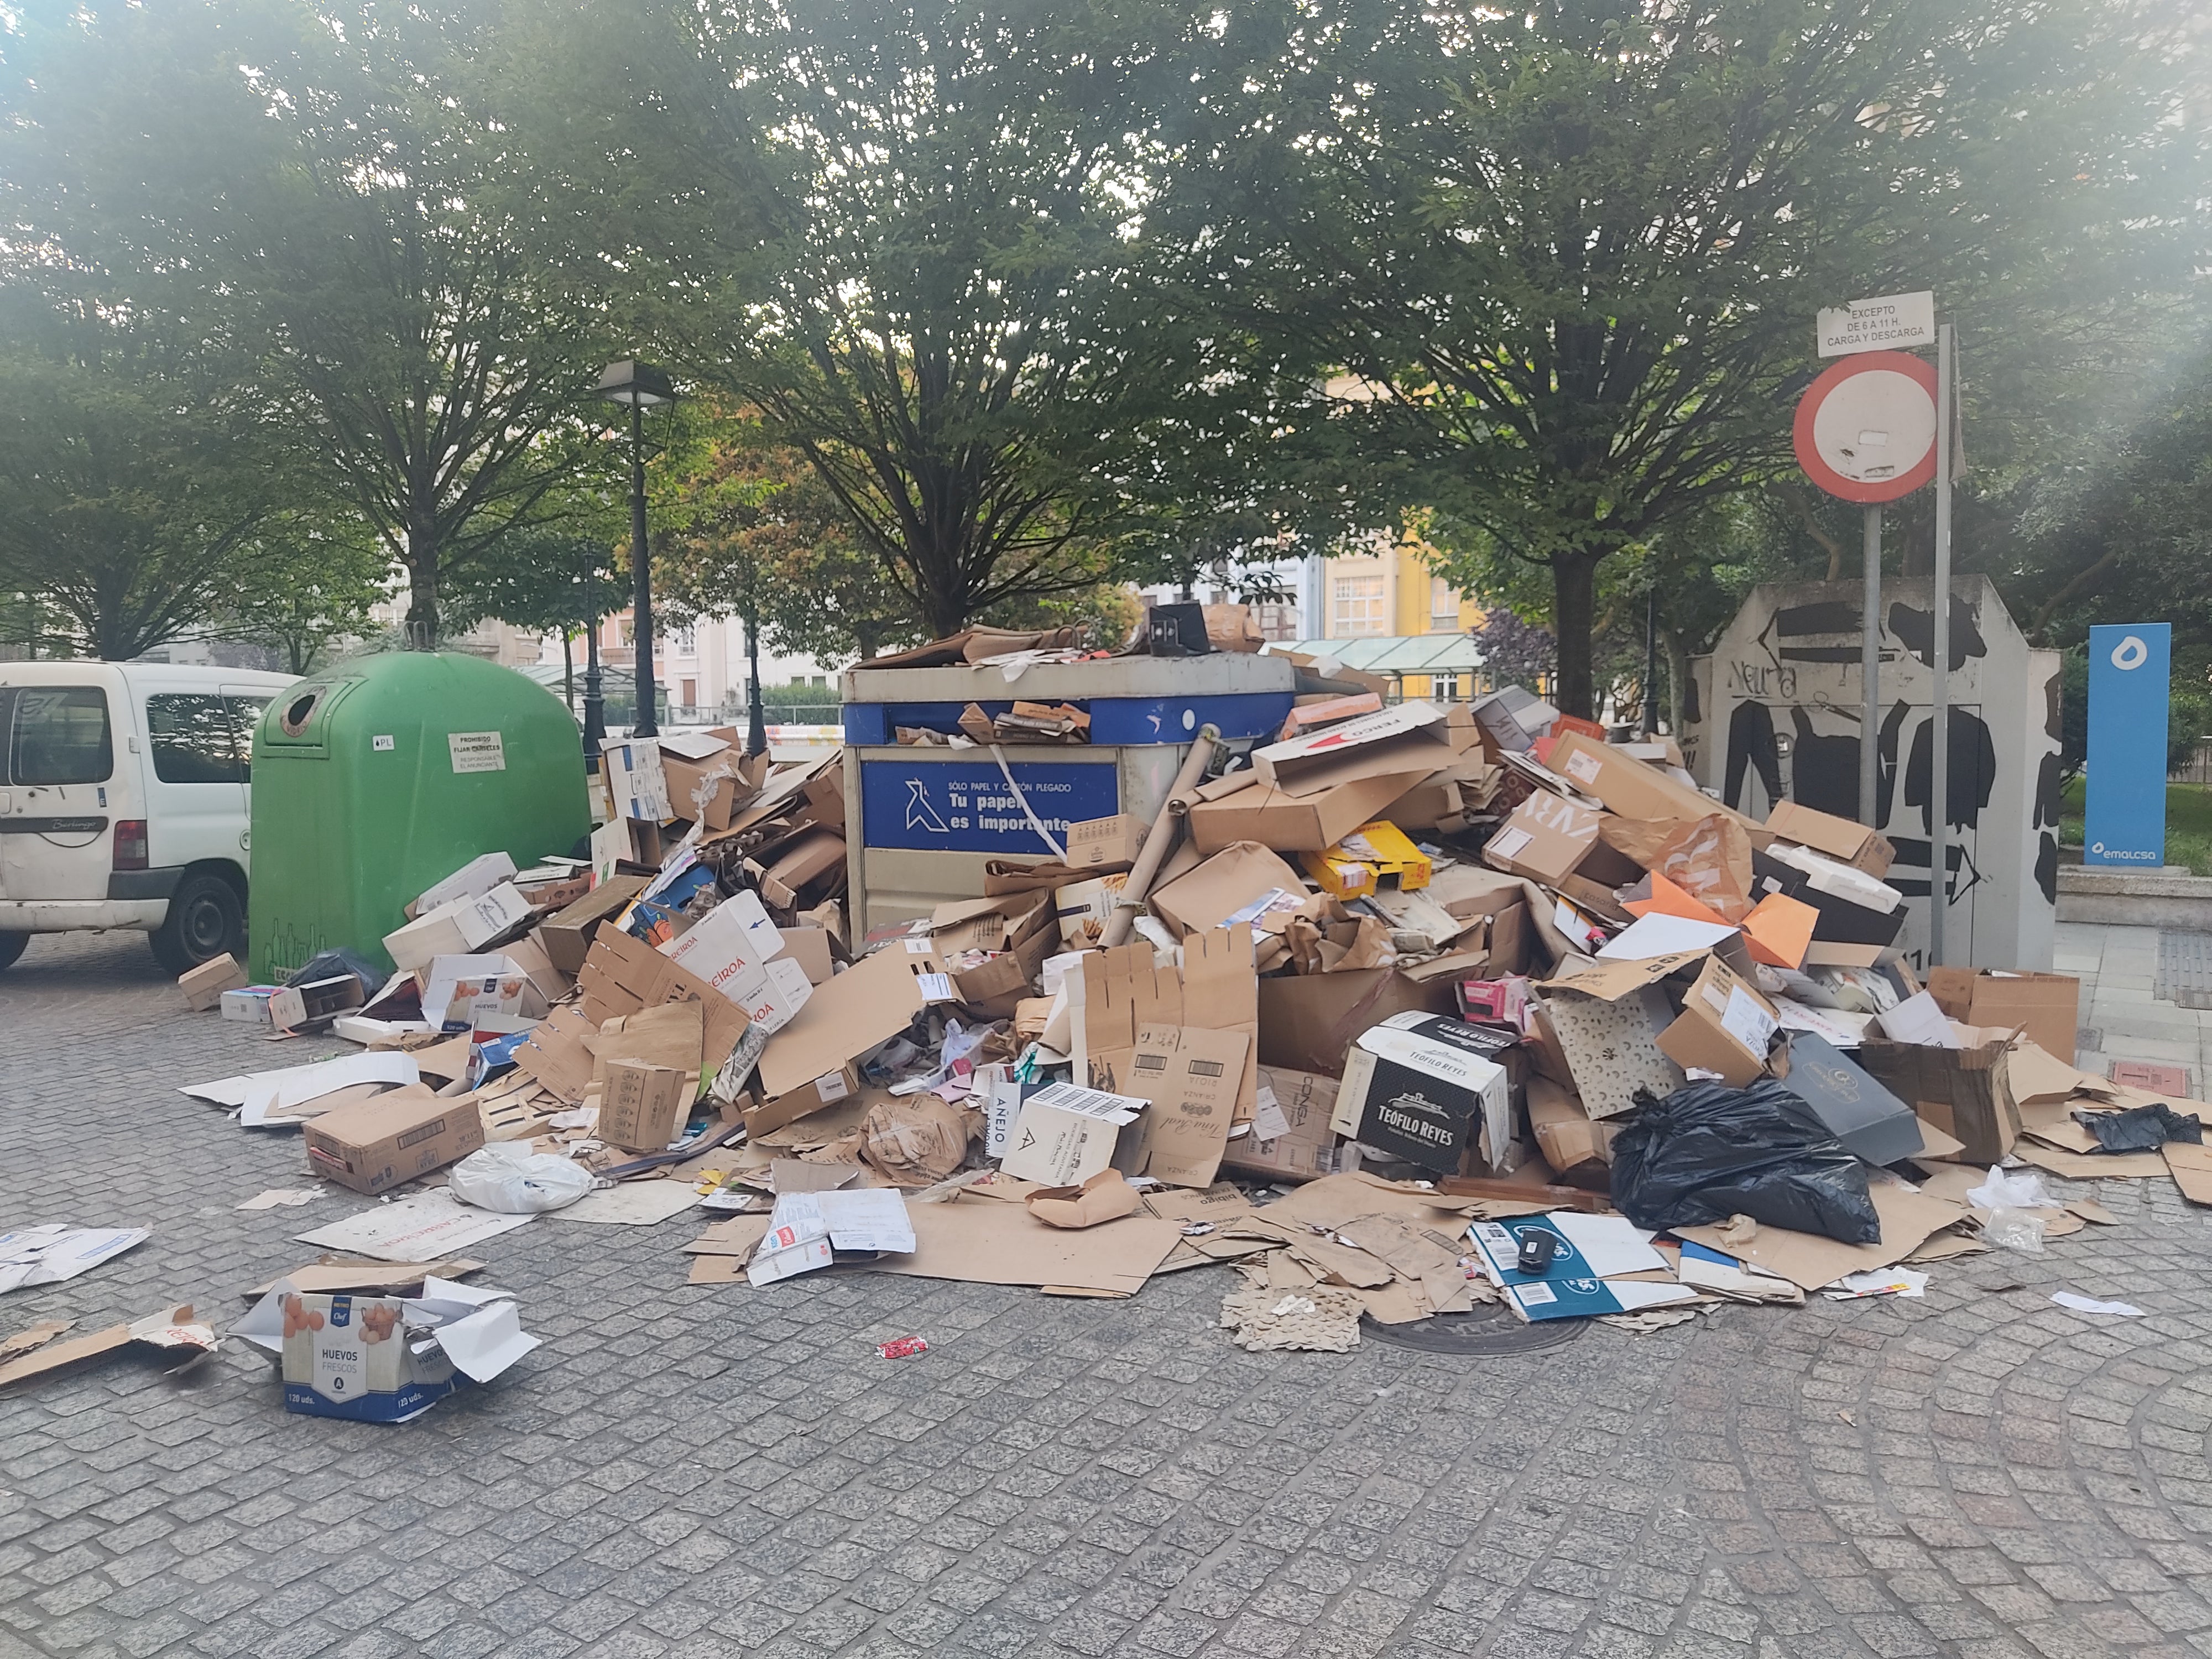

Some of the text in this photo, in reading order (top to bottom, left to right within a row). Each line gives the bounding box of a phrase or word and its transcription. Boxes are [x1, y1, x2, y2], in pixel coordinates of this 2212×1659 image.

[1852, 306, 1895, 319] EXCEPTO
[1848, 323, 1860, 332] DE
[1870, 321, 1877, 329] A
[1880, 319, 1889, 327] 11
[1891, 317, 1901, 326] H.
[1828, 336, 1861, 346] CARGA
[1872, 327, 1924, 341] DESCARGA
[1352, 717, 1401, 737] FERCO
[380, 738, 392, 747] PL
[948, 780, 1072, 792] SÓLO PAPEL Y CATÓN PLEGADO
[950, 793, 967, 807] Tu
[53, 820, 96, 830] Berlingo
[951, 817, 969, 829] es
[2103, 850, 2156, 860] emalcsa
[1437, 1022, 1469, 1035] REYES
[1441, 1062, 1468, 1077] REYES
[1188, 1076, 1218, 1086] RIOJA
[1182, 1091, 1217, 1100] CRIANZA
[1294, 1076, 1314, 1128] CONGA
[995, 1097, 1008, 1143] AÑEJO
[1377, 1105, 1420, 1134] TEÓFILO
[1417, 1121, 1455, 1146] REYES
[1166, 1165, 1200, 1176] CRIANZA
[1199, 1192, 1239, 1206] bibigo
[333, 1312, 347, 1321] Chef
[322, 1348, 358, 1361] HUEVOS
[322, 1362, 357, 1374] FRESCOS
[288, 1393, 315, 1405] 120 uds.
[398, 1391, 424, 1408] 120 uds.
